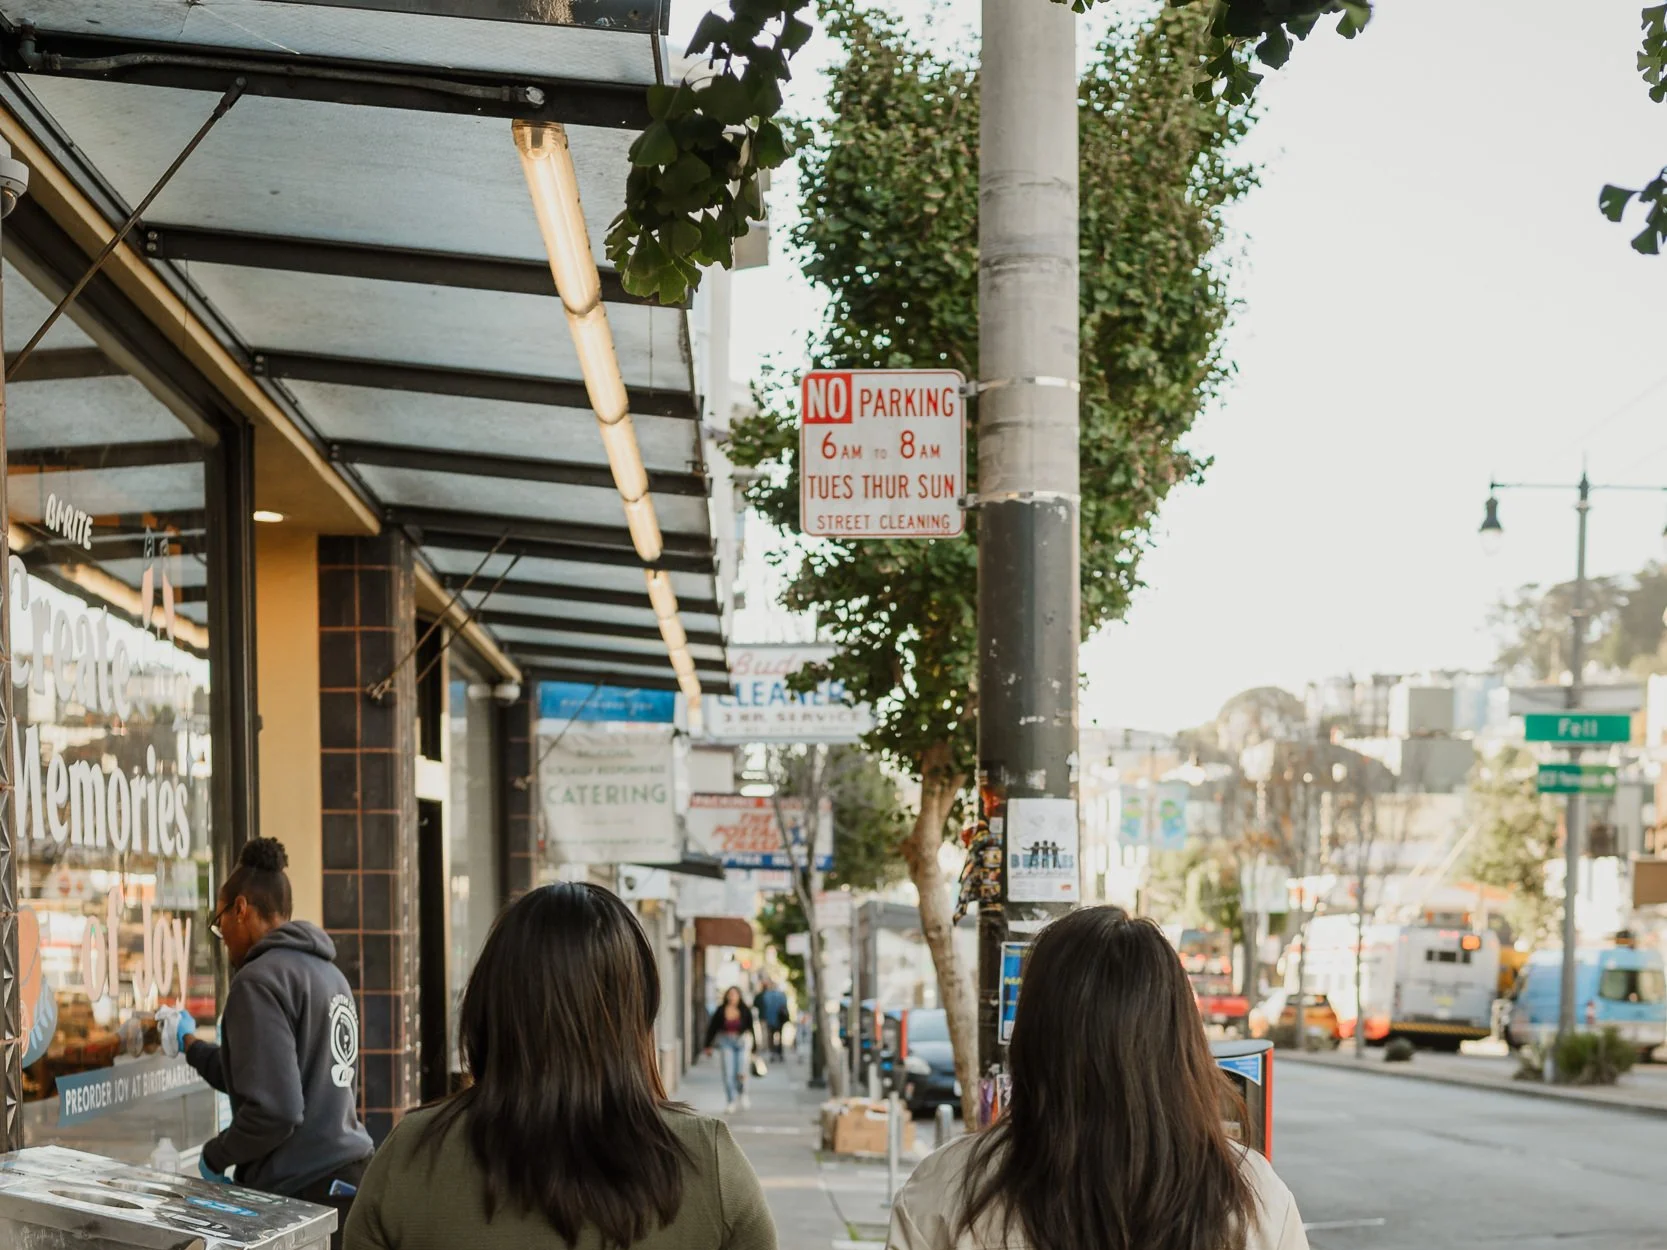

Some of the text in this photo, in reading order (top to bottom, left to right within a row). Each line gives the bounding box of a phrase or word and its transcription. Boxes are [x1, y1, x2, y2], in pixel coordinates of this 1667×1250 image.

[807, 377, 954, 419] NO PARKING
[808, 474, 954, 499] TUES THUR SUN
[817, 514, 949, 530] STREET CLEANING
[9, 555, 131, 720] Create
[1558, 718, 1598, 738] Fell
[12, 716, 190, 859] Memories
[546, 784, 666, 805] CATERING
[82, 886, 191, 1010] of Joy
[65, 1082, 112, 1116] PREORDER
[114, 1076, 128, 1103] JOY
[131, 1074, 141, 1098] AT
